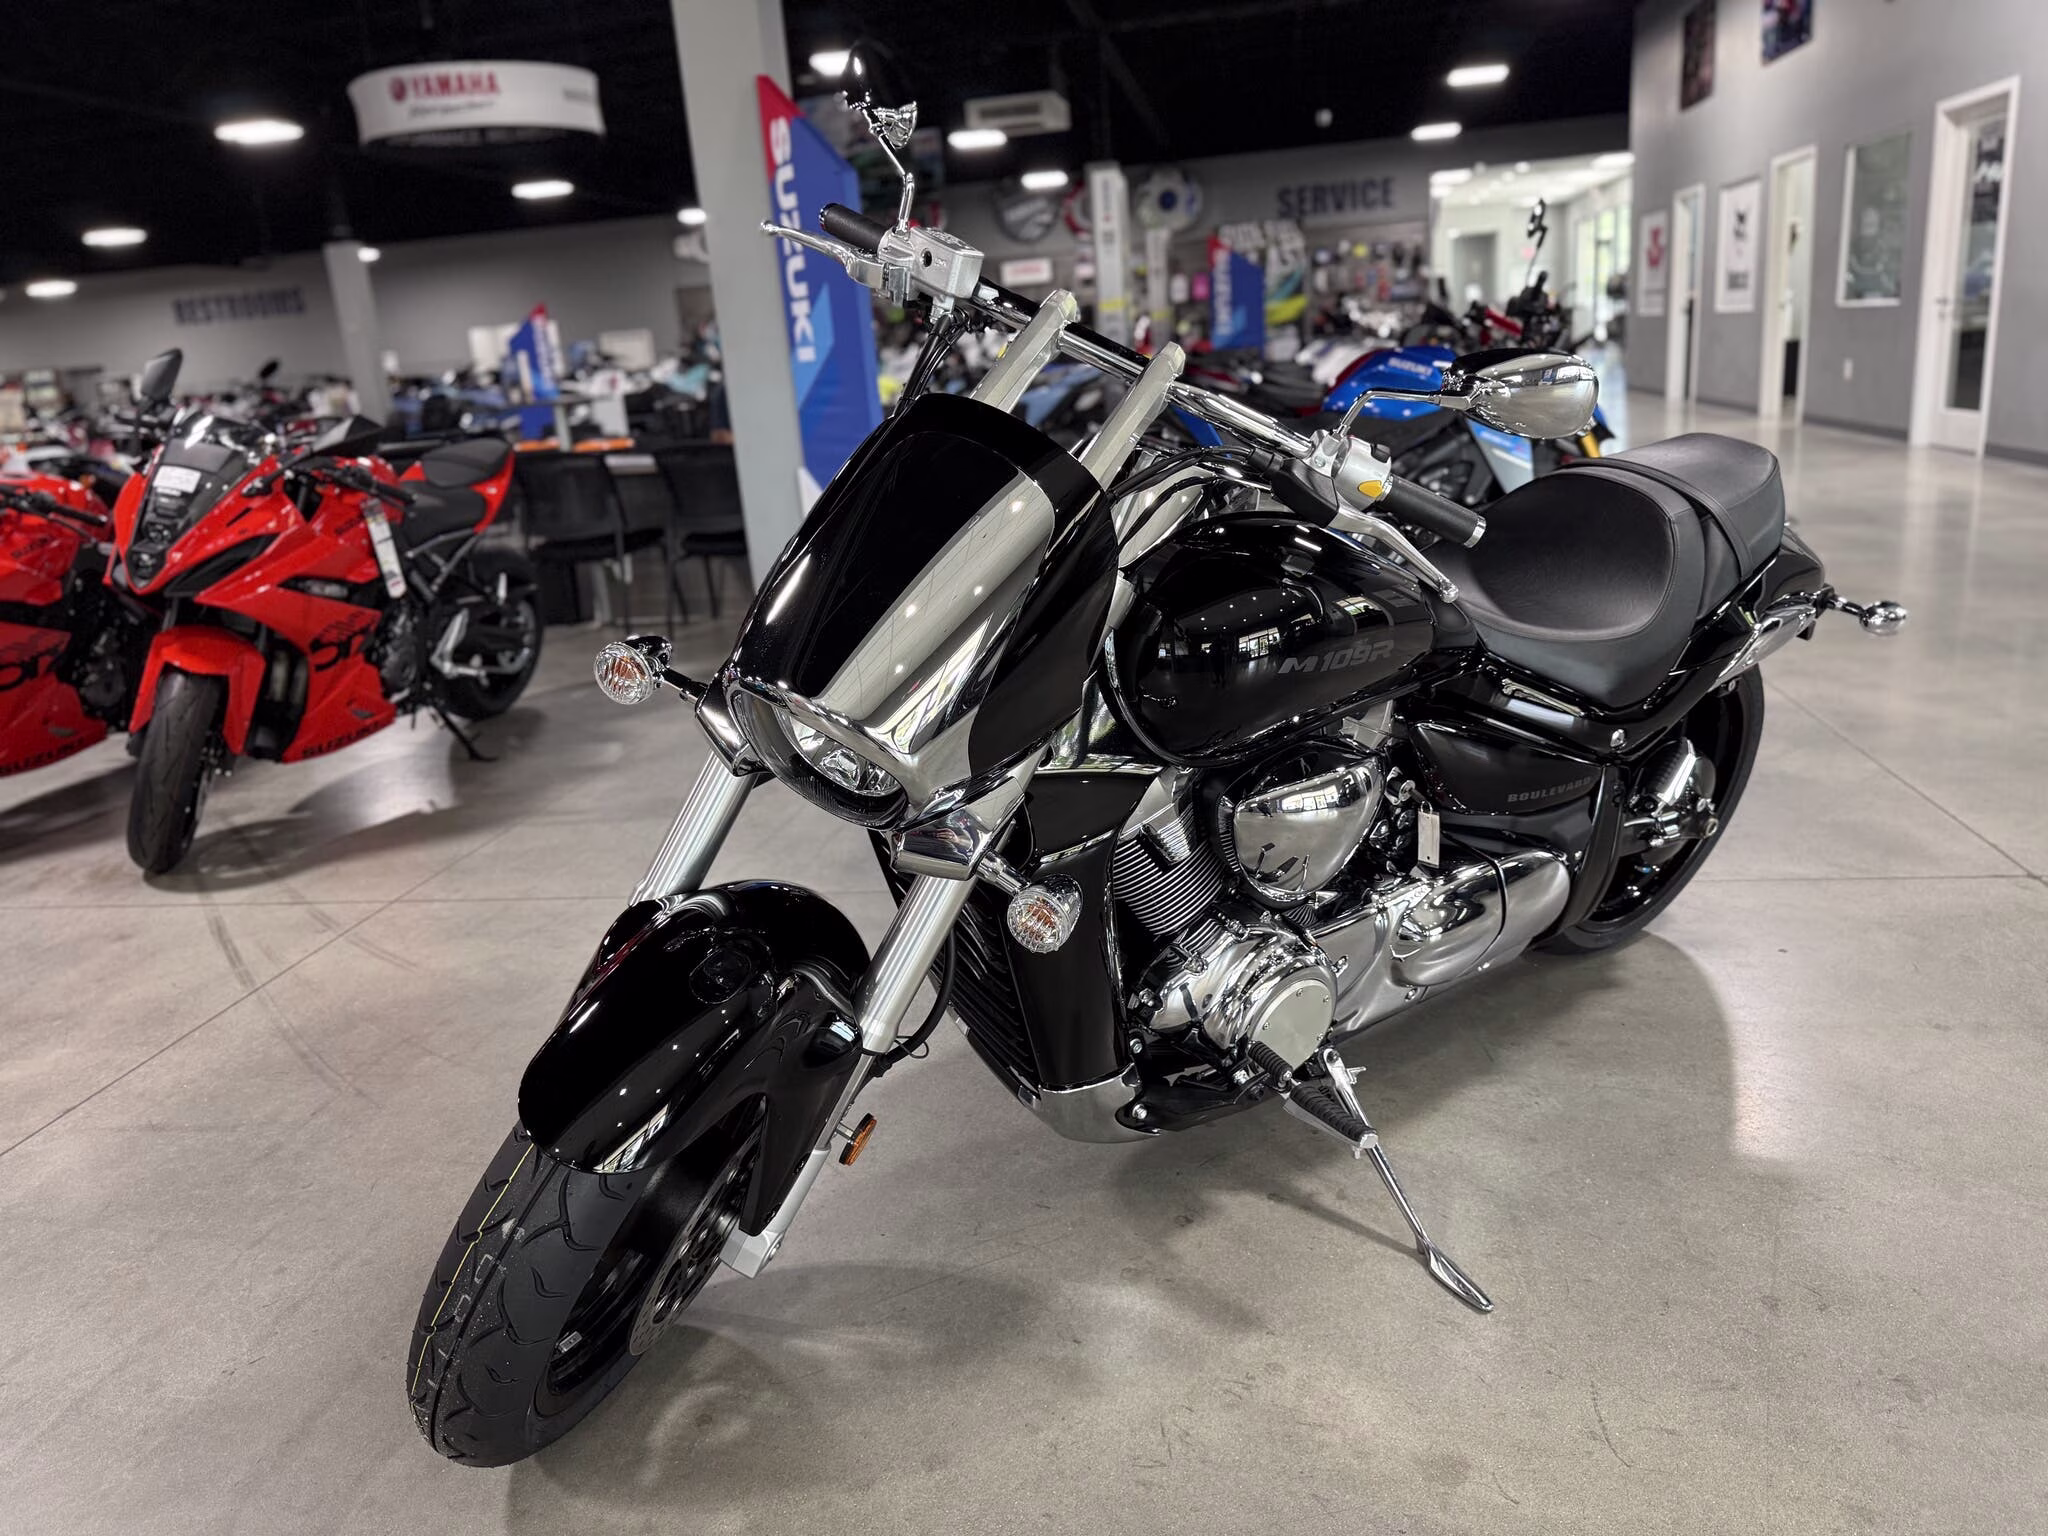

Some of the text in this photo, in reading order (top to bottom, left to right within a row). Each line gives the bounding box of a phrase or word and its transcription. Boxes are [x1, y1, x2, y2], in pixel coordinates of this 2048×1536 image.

[411, 71, 499, 97] YAMAHA
[1278, 176, 1395, 218] SERVICE
[769, 116, 816, 362] SUZUKI
[174, 286, 306, 327] RESTROOMS
[1507, 776, 1592, 802] BOULEVARD
